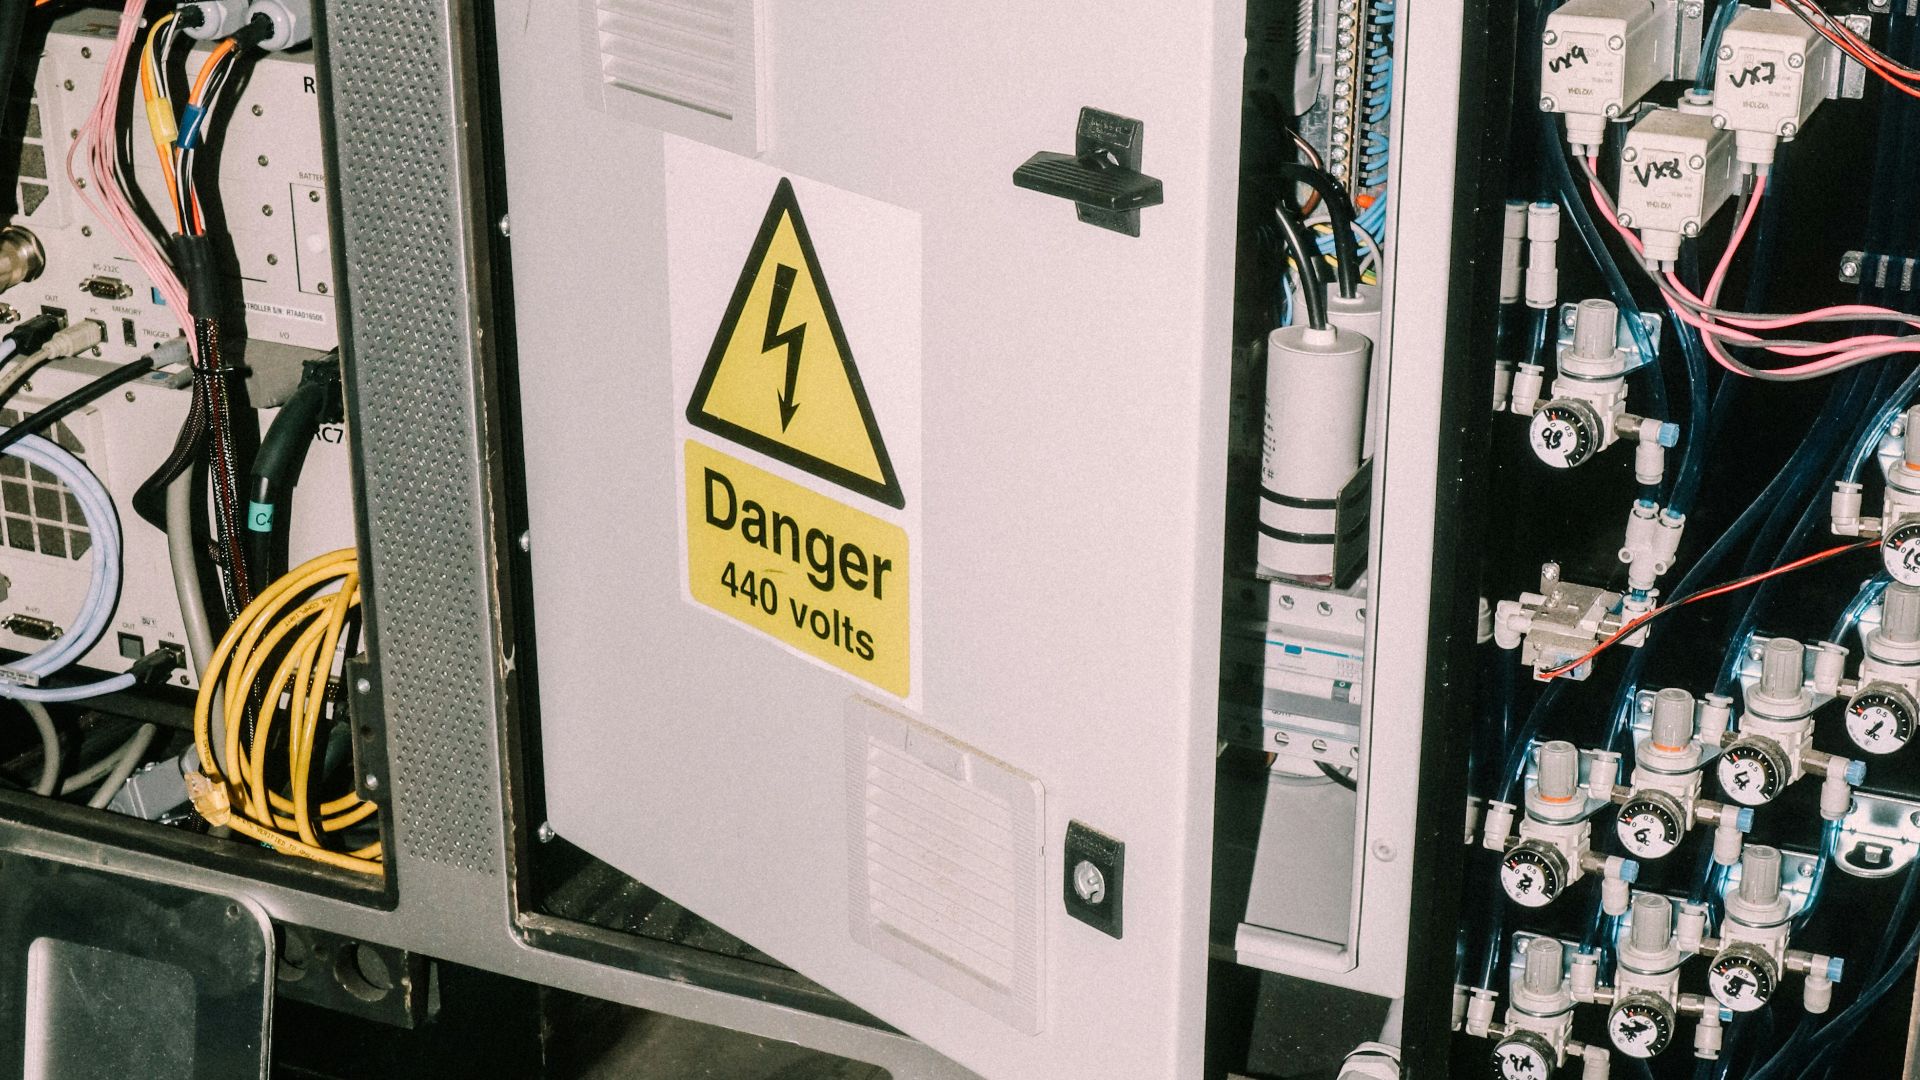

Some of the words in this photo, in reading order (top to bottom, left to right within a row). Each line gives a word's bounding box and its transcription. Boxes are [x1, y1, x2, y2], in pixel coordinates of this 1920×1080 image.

[111, 305, 142, 316] MEMORY
[142, 328, 170, 339] TRIGGER
[704, 466, 892, 601] Danger
[720, 561, 778, 616] 440
[789, 597, 875, 662] volts
[1876, 708, 1888, 718] 0.5
[1748, 761, 1759, 773] 0.5
[1643, 814, 1655, 824] 0.5
[1526, 864, 1538, 875] 0.5
[1737, 969, 1750, 979] 0.5
